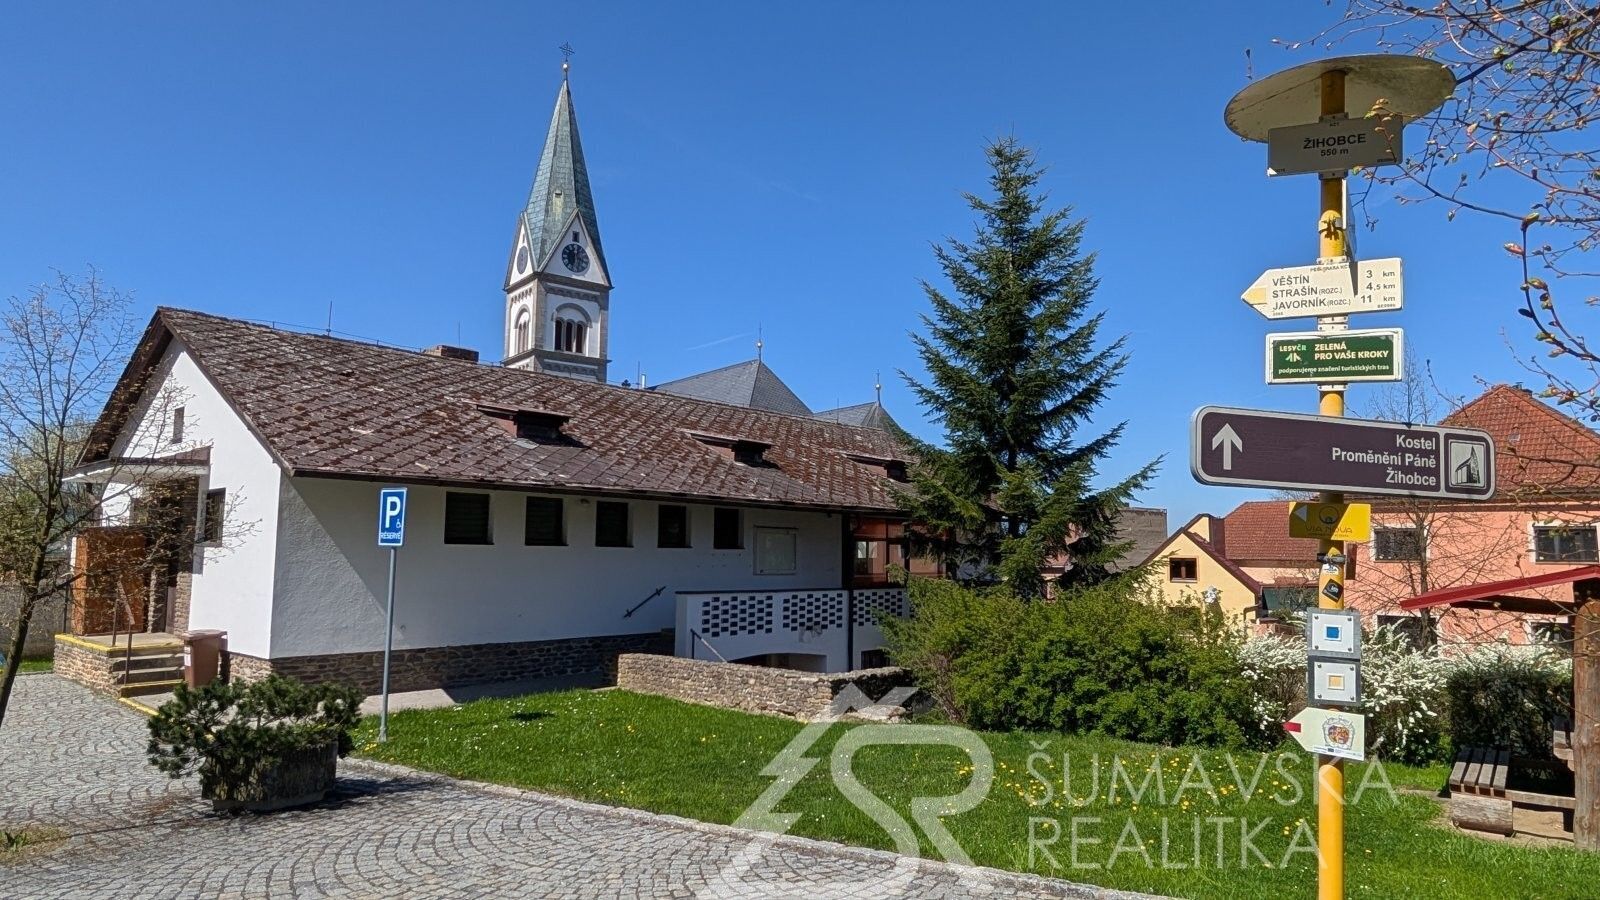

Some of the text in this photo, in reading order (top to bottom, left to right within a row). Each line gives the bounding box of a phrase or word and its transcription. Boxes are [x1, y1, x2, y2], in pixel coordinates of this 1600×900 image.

[1303, 133, 1366, 149] ŽIHOBCE
[1320, 148, 1337, 156] 550
[1272, 274, 1310, 287] VĚŠTÍN
[1366, 270, 1373, 278] 3
[1272, 285, 1318, 299] STRAŠÍN
[1318, 287, 1342, 296] (ROZC.)
[1366, 282, 1381, 291] 4,5
[1272, 296, 1327, 310] JAVORNÍK
[1360, 295, 1372, 304] 11
[1314, 341, 1347, 351] ZELENÁ
[1314, 350, 1389, 360] PRO VAŠE KROKY
[1278, 367, 1317, 375] podporujeme
[1341, 364, 1377, 373] turistických
[1396, 434, 1436, 450] Kostel
[1332, 447, 1436, 468] Proměnění Páně
[1385, 467, 1437, 486] Žihobce
[385, 496, 401, 528] P
[1305, 525, 1353, 534] VIA NOVA
